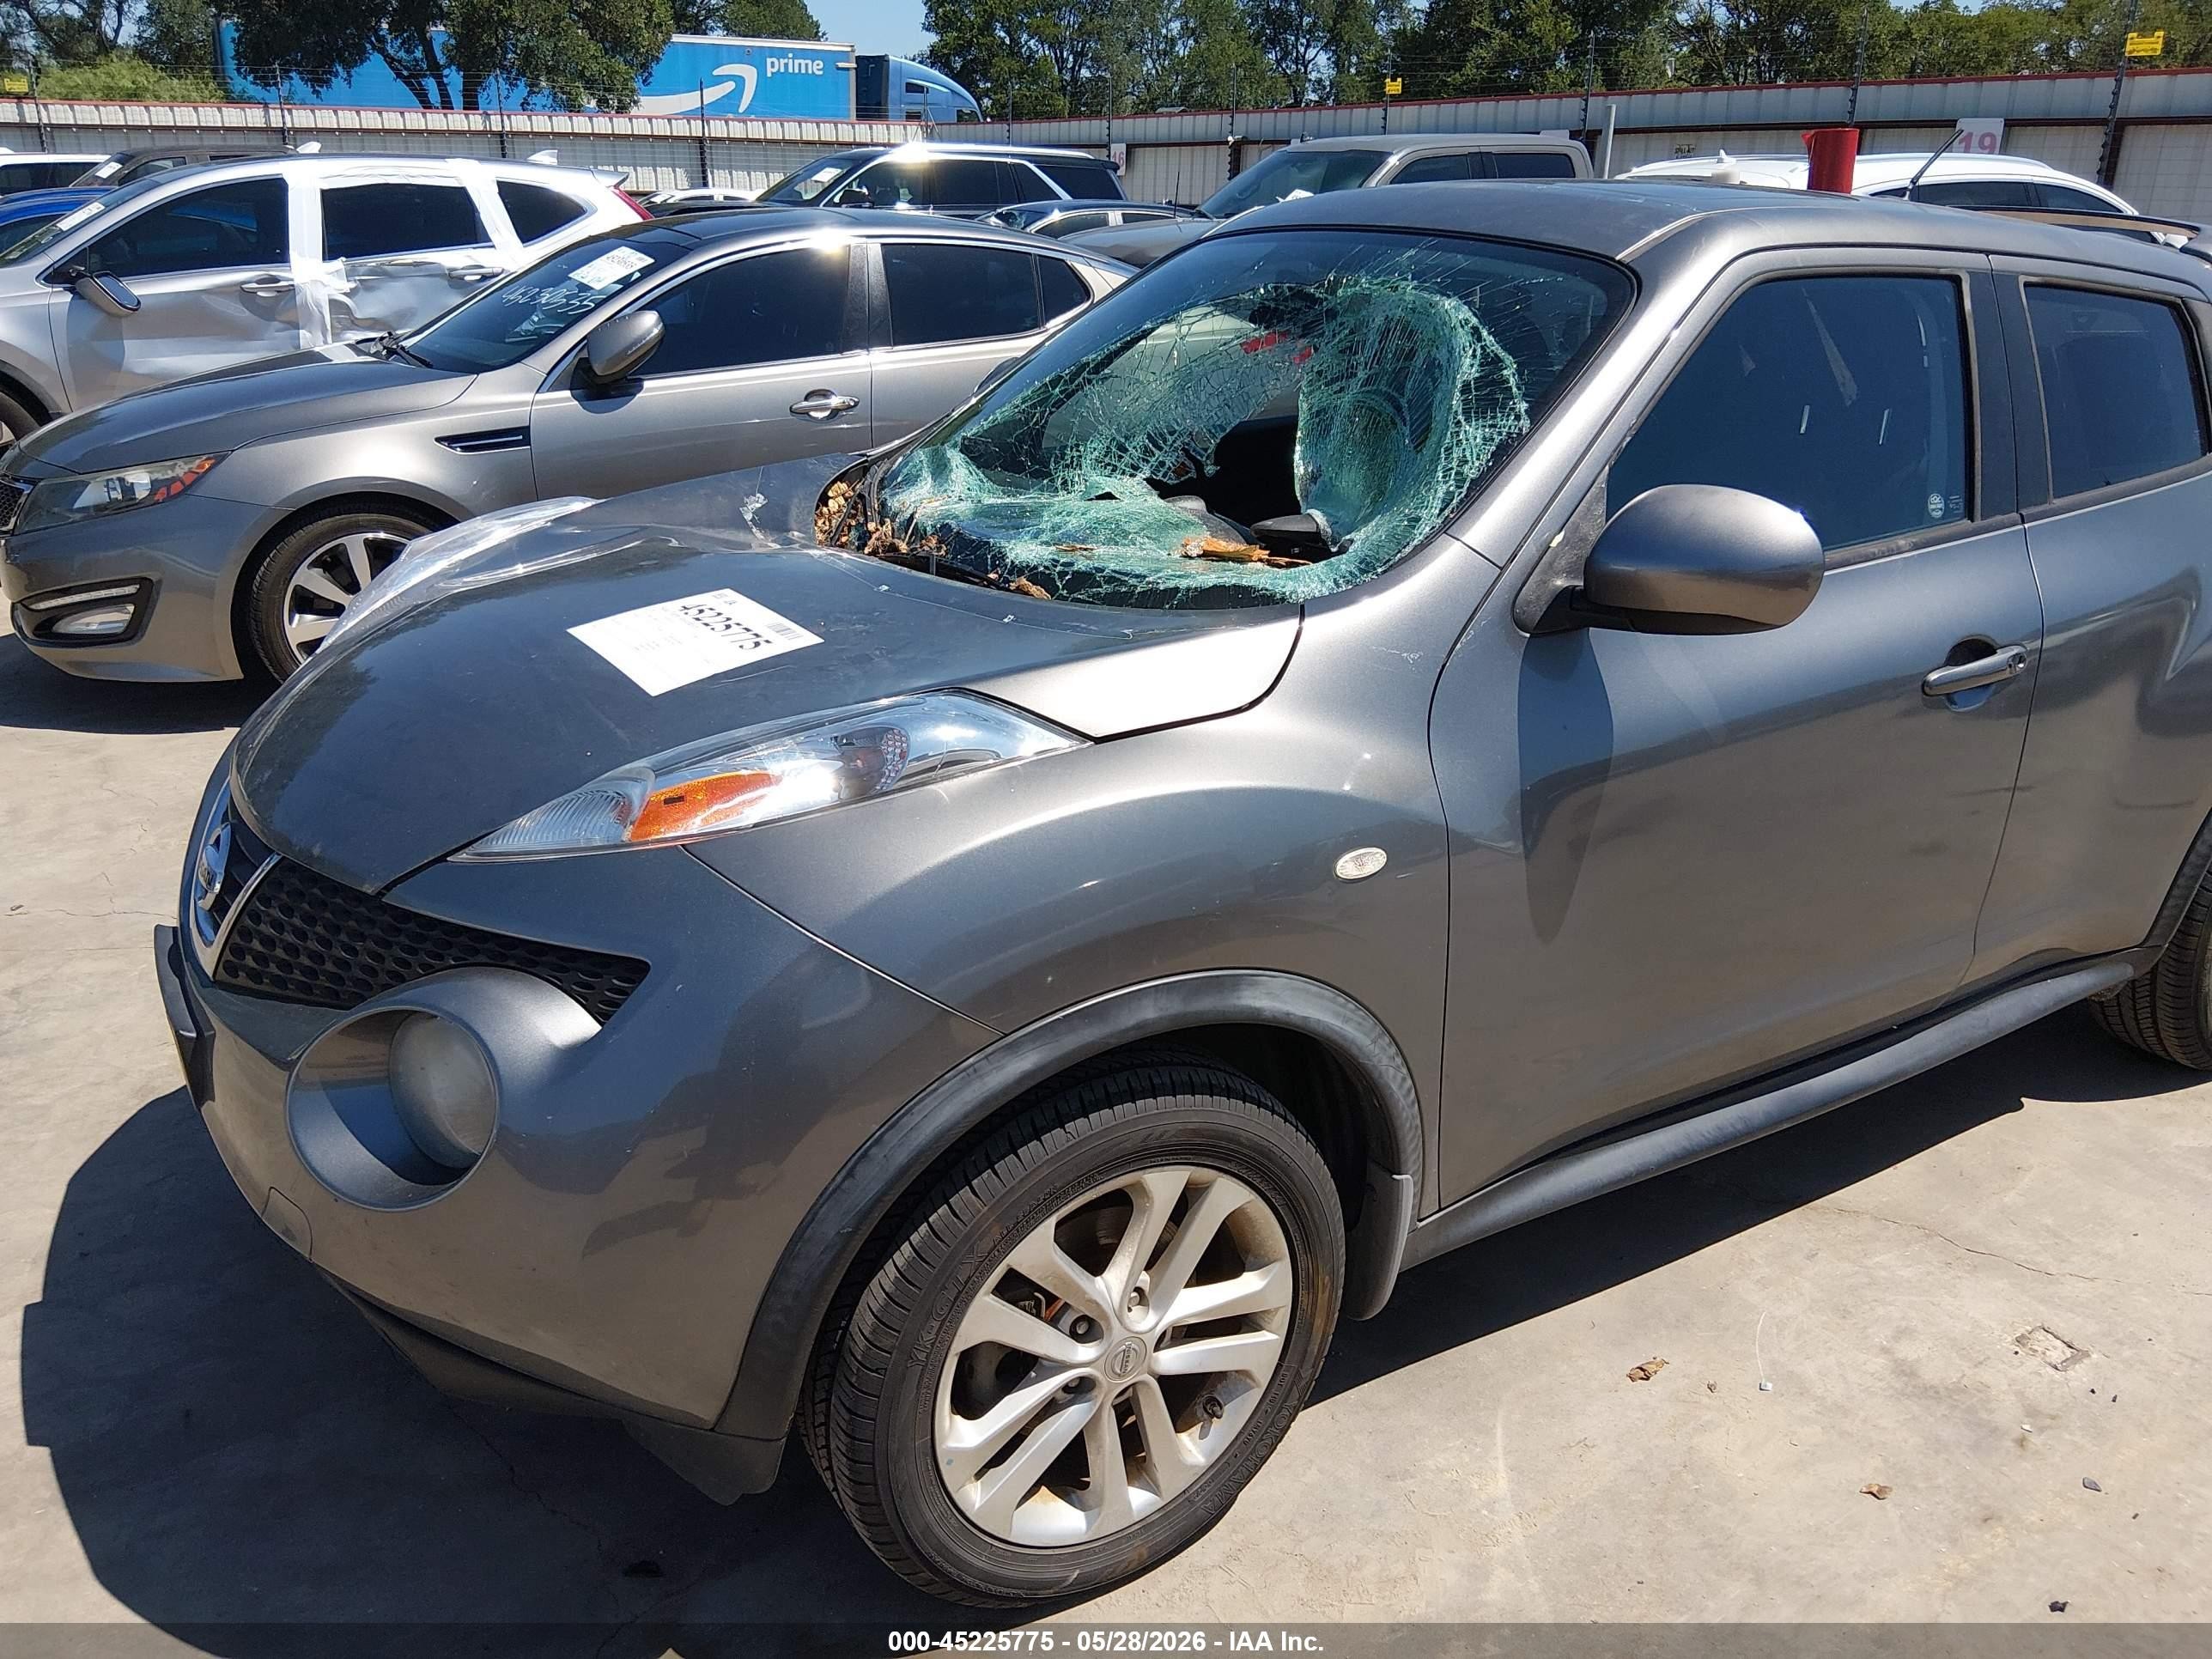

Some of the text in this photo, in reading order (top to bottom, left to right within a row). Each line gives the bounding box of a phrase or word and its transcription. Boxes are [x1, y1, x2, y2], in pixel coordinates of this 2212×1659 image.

[766, 52, 823, 77] prime
[1959, 131, 1997, 155] 19
[677, 603, 773, 651] 45225775
[1200, 1401, 1298, 1515] YOKOHAMA
